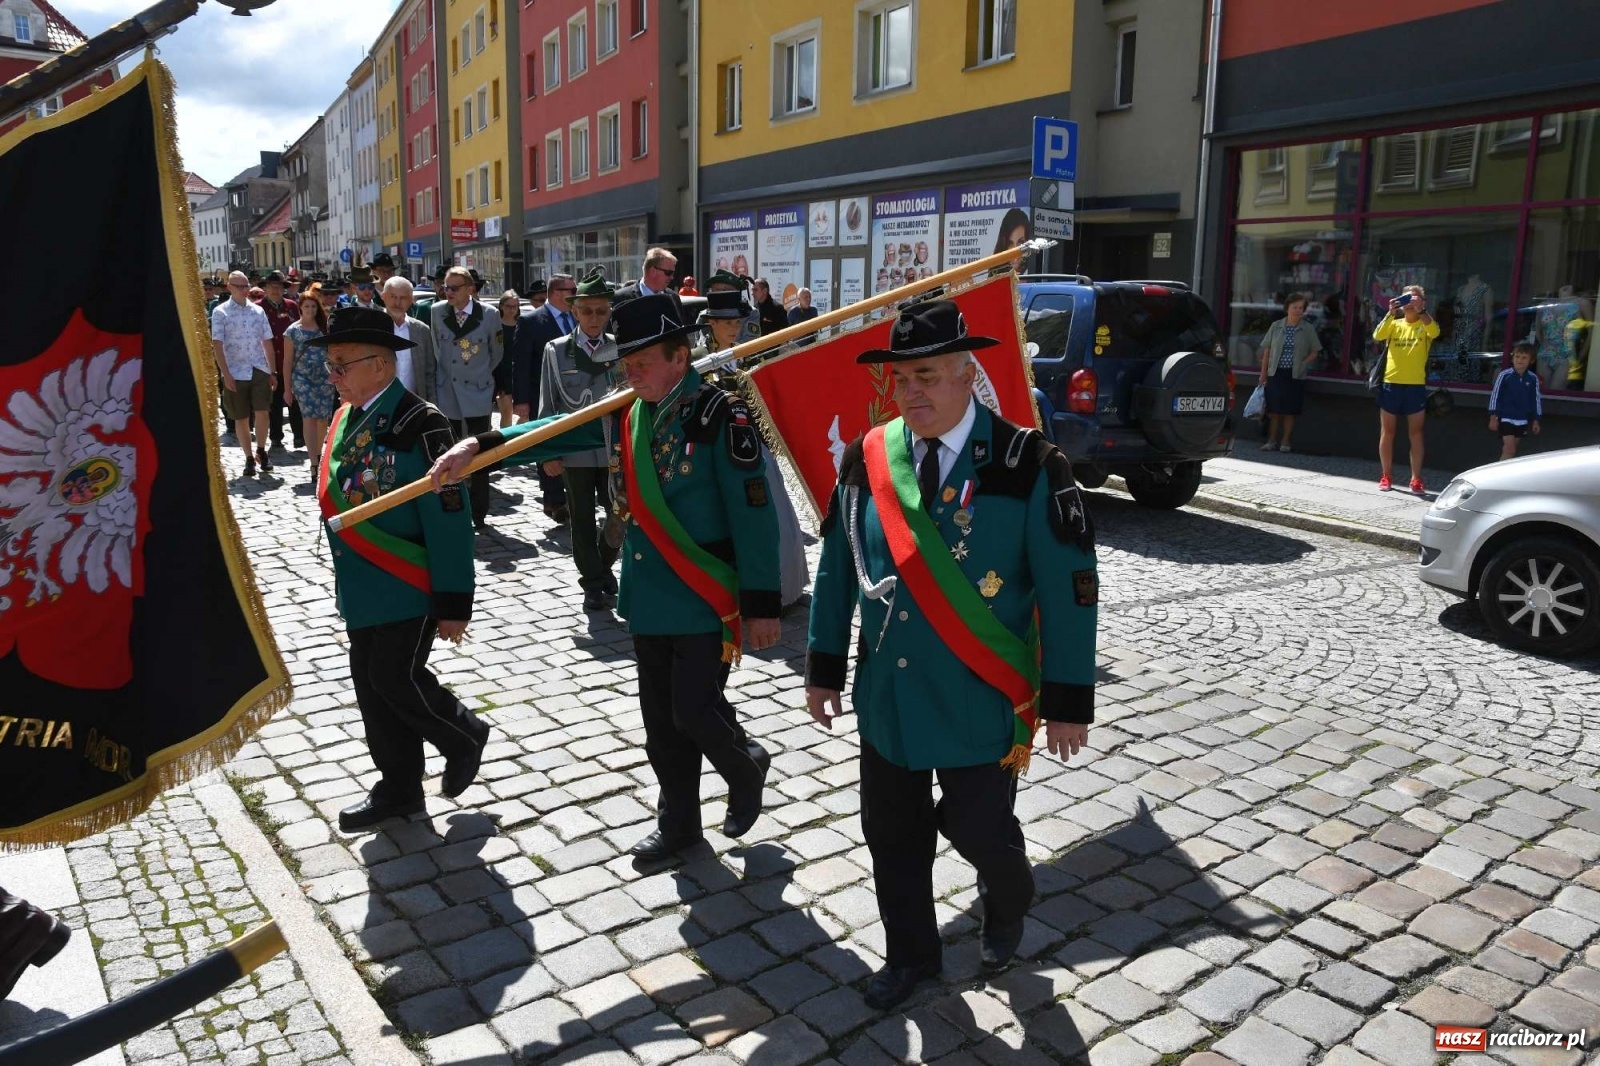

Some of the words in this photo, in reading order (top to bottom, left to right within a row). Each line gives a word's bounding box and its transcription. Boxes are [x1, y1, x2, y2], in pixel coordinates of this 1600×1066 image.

[1043, 125, 1070, 171] P
[961, 188, 1016, 208] PROTETYKA
[876, 197, 936, 216] STOMATOLOGIA
[714, 217, 751, 231] STOMATOLOGIA
[765, 212, 798, 226] PROTETYKA
[1035, 213, 1045, 221] dla
[409, 243, 420, 256] P
[1156, 239, 1168, 251] 52
[1179, 398, 1197, 411] SRC
[1200, 398, 1223, 410] 4YV4
